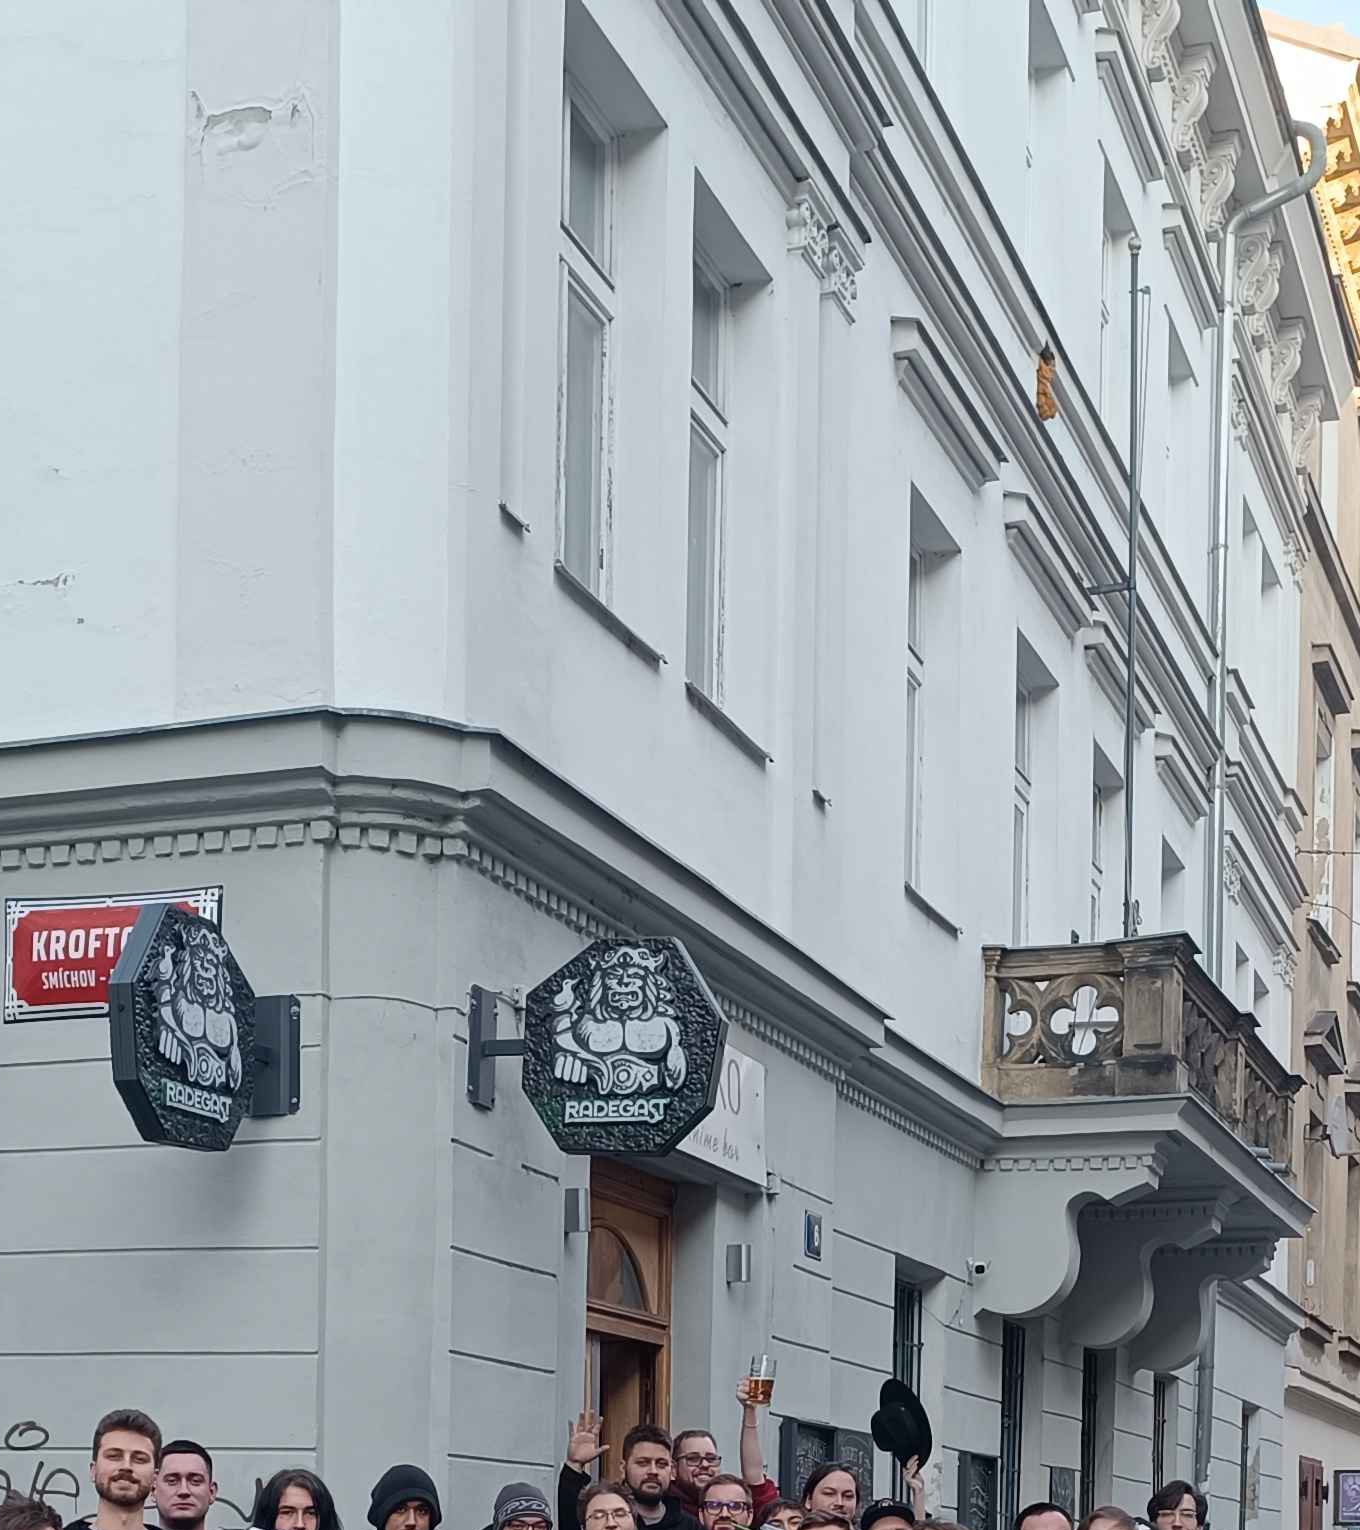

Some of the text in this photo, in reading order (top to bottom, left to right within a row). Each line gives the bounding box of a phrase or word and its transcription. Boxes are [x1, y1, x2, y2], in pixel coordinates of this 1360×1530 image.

[41, 967, 96, 990] SMÍCHOV
[166, 1082, 233, 1124] RADEGAST
[565, 1098, 670, 1123] RADEGAST
